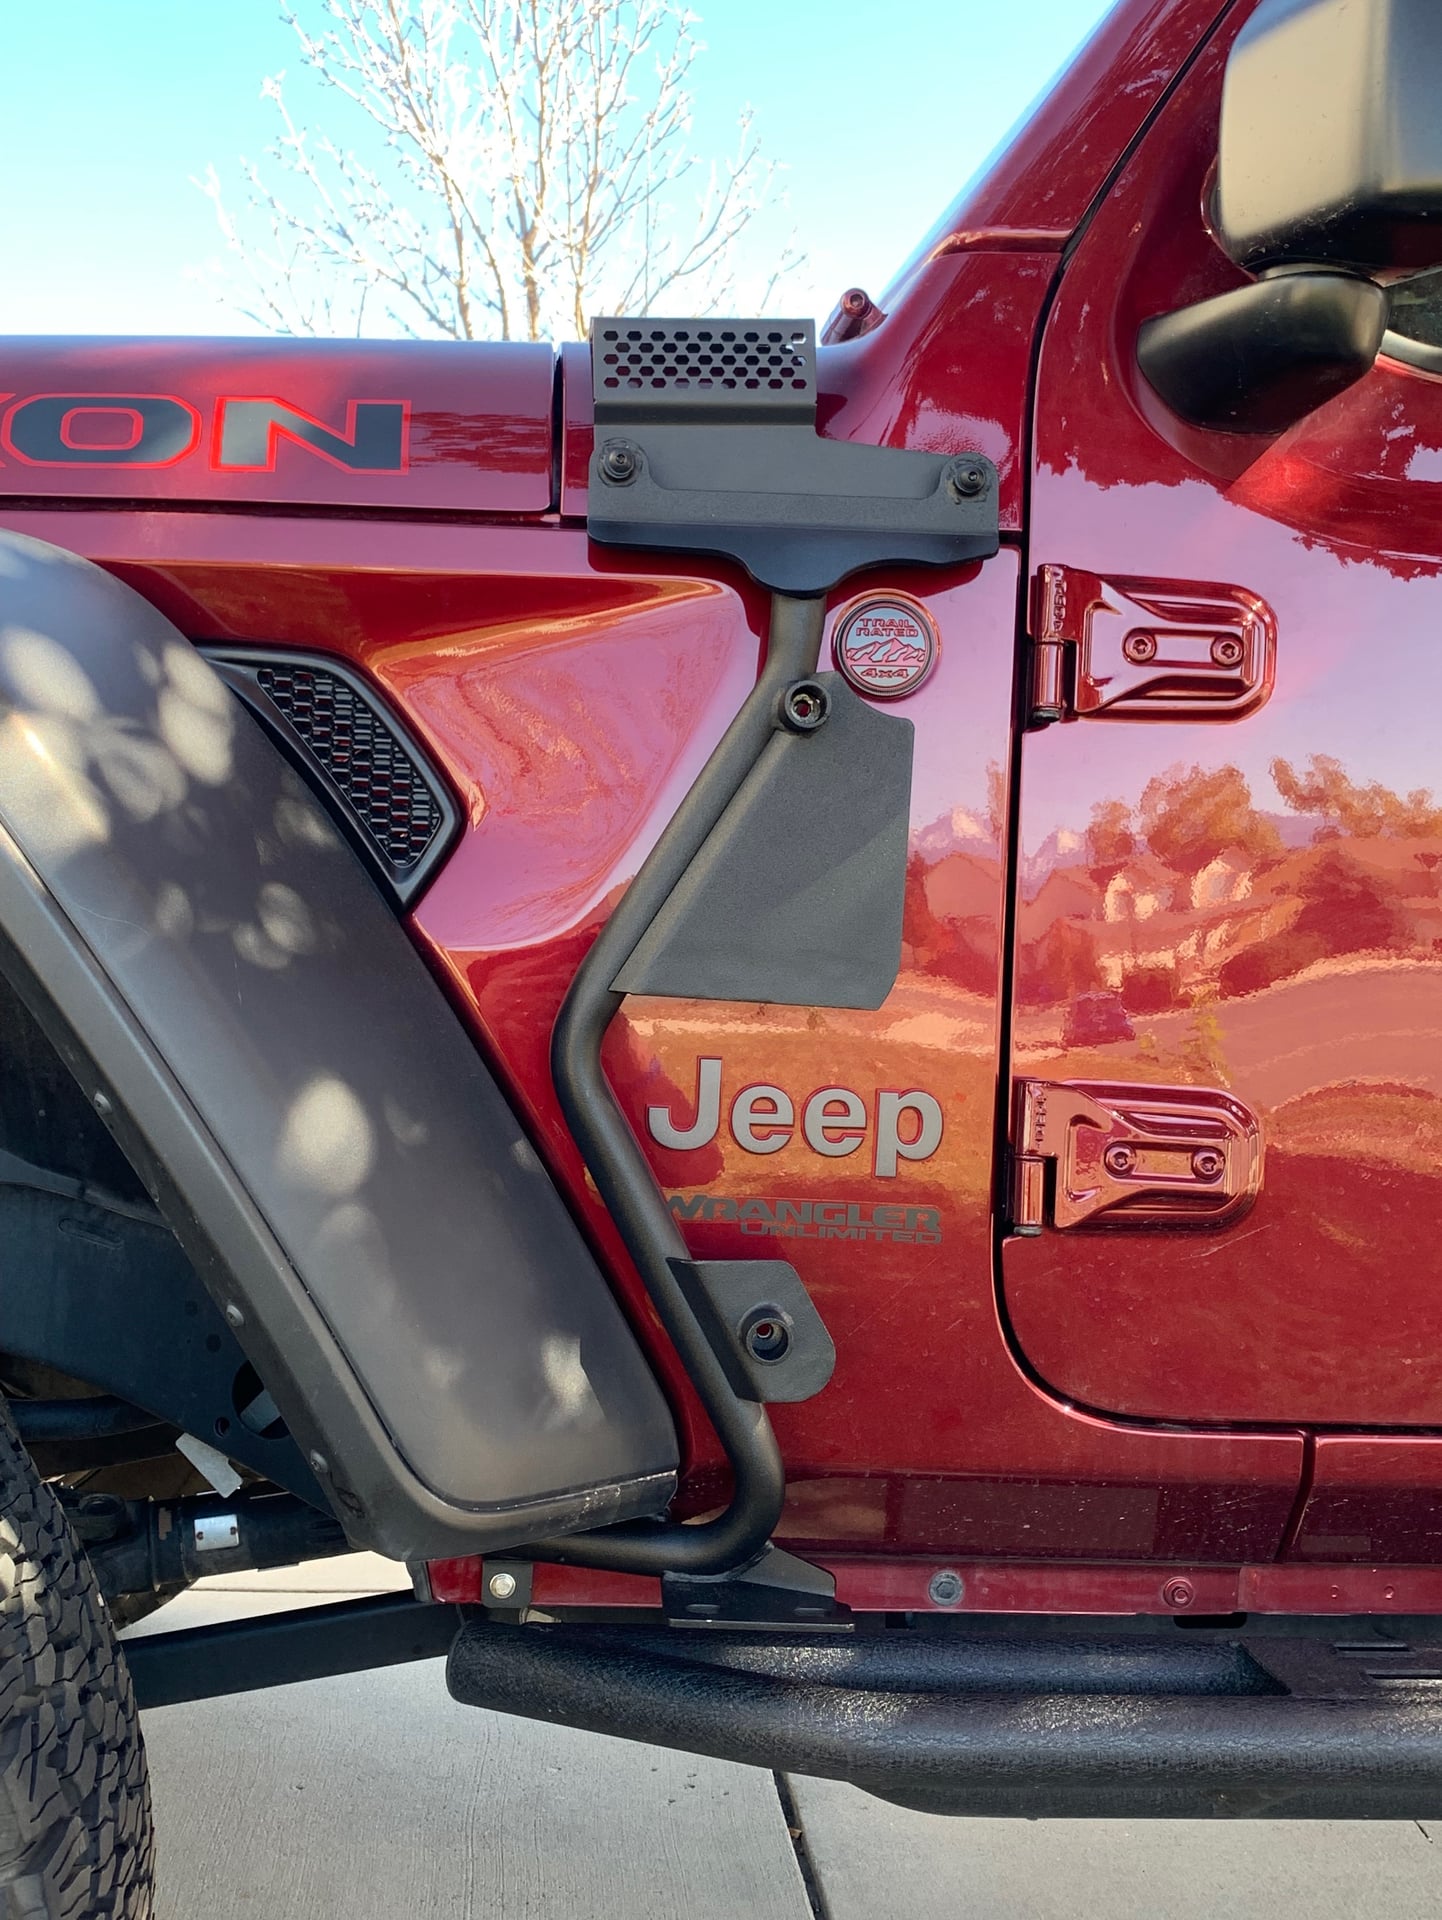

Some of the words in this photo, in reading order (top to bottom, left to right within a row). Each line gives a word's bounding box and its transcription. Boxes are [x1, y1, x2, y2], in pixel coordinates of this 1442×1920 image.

[0, 392, 411, 476] ON
[860, 618, 915, 628] TRAIL
[856, 628, 919, 637] RATED
[861, 668, 909, 678] 4x4
[647, 1056, 943, 1178] Jeep
[741, 1222, 942, 1244] UNLIMITED
